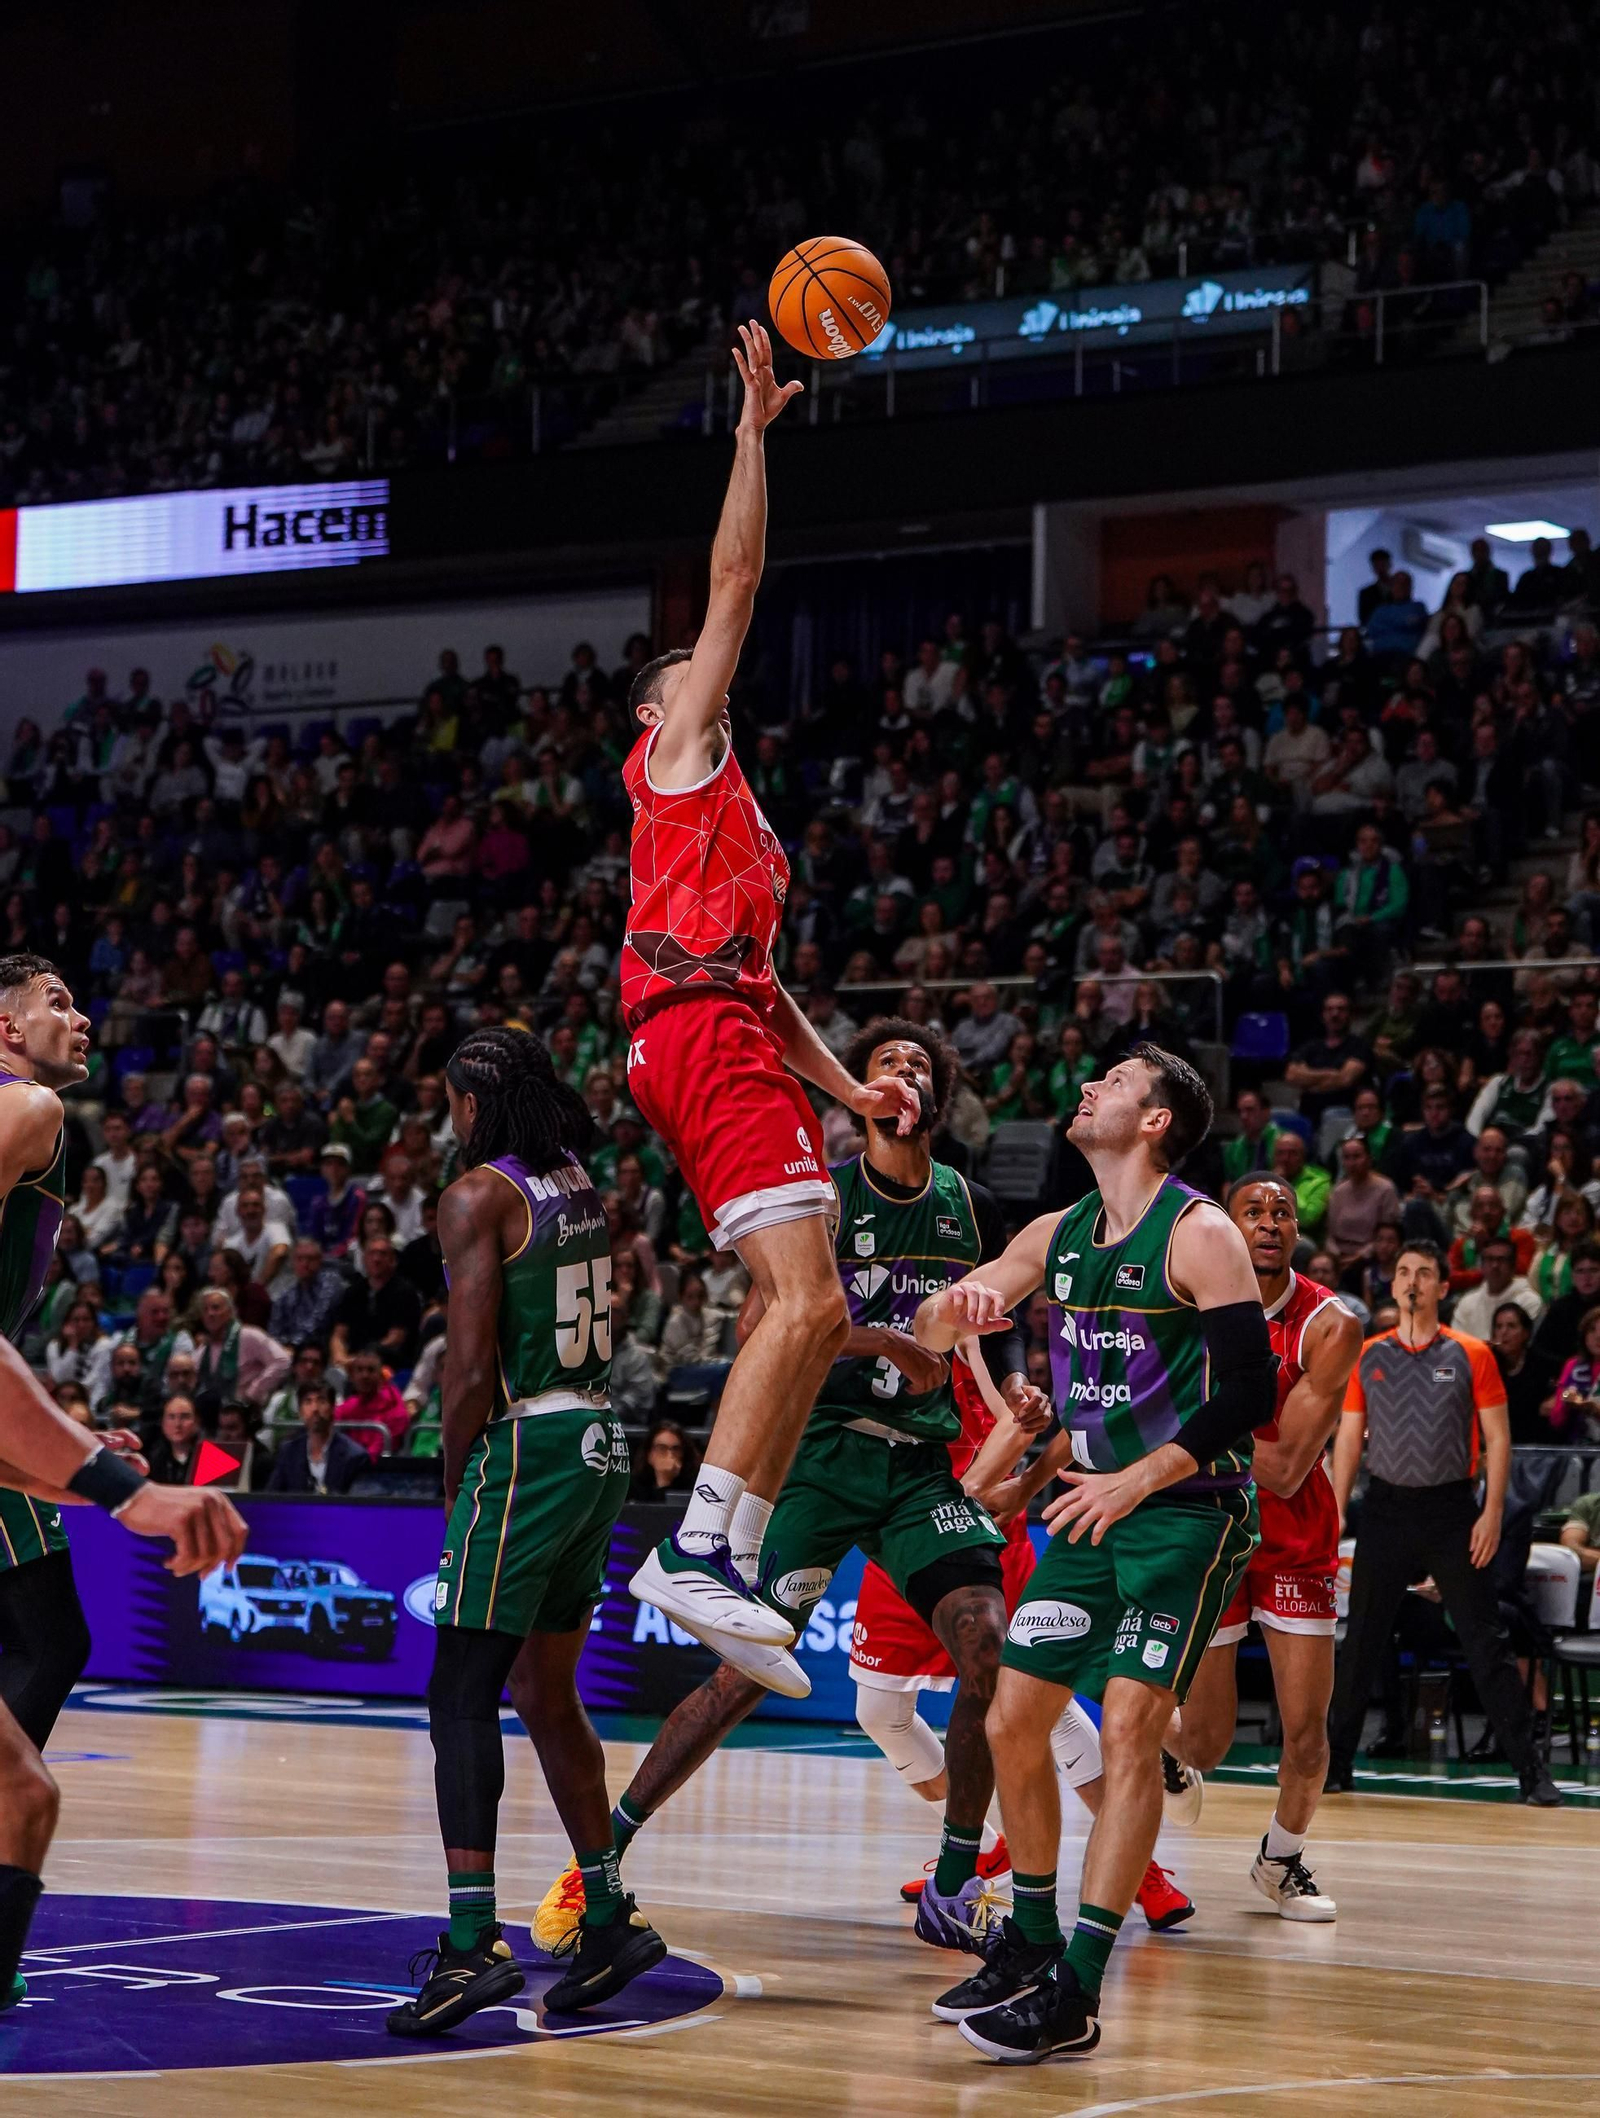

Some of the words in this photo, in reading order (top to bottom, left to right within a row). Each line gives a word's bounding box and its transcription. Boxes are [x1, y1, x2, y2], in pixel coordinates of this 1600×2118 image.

[555, 1256, 612, 1369] 55
[871, 1355, 902, 1399] 3
[934, 1516, 978, 1534] laga
[1275, 1583, 1303, 1599] ETL
[1275, 1599, 1325, 1613] GLOBAL
[1010, 1604, 1088, 1634] famadesa
[1152, 1619, 1172, 1631] acb
